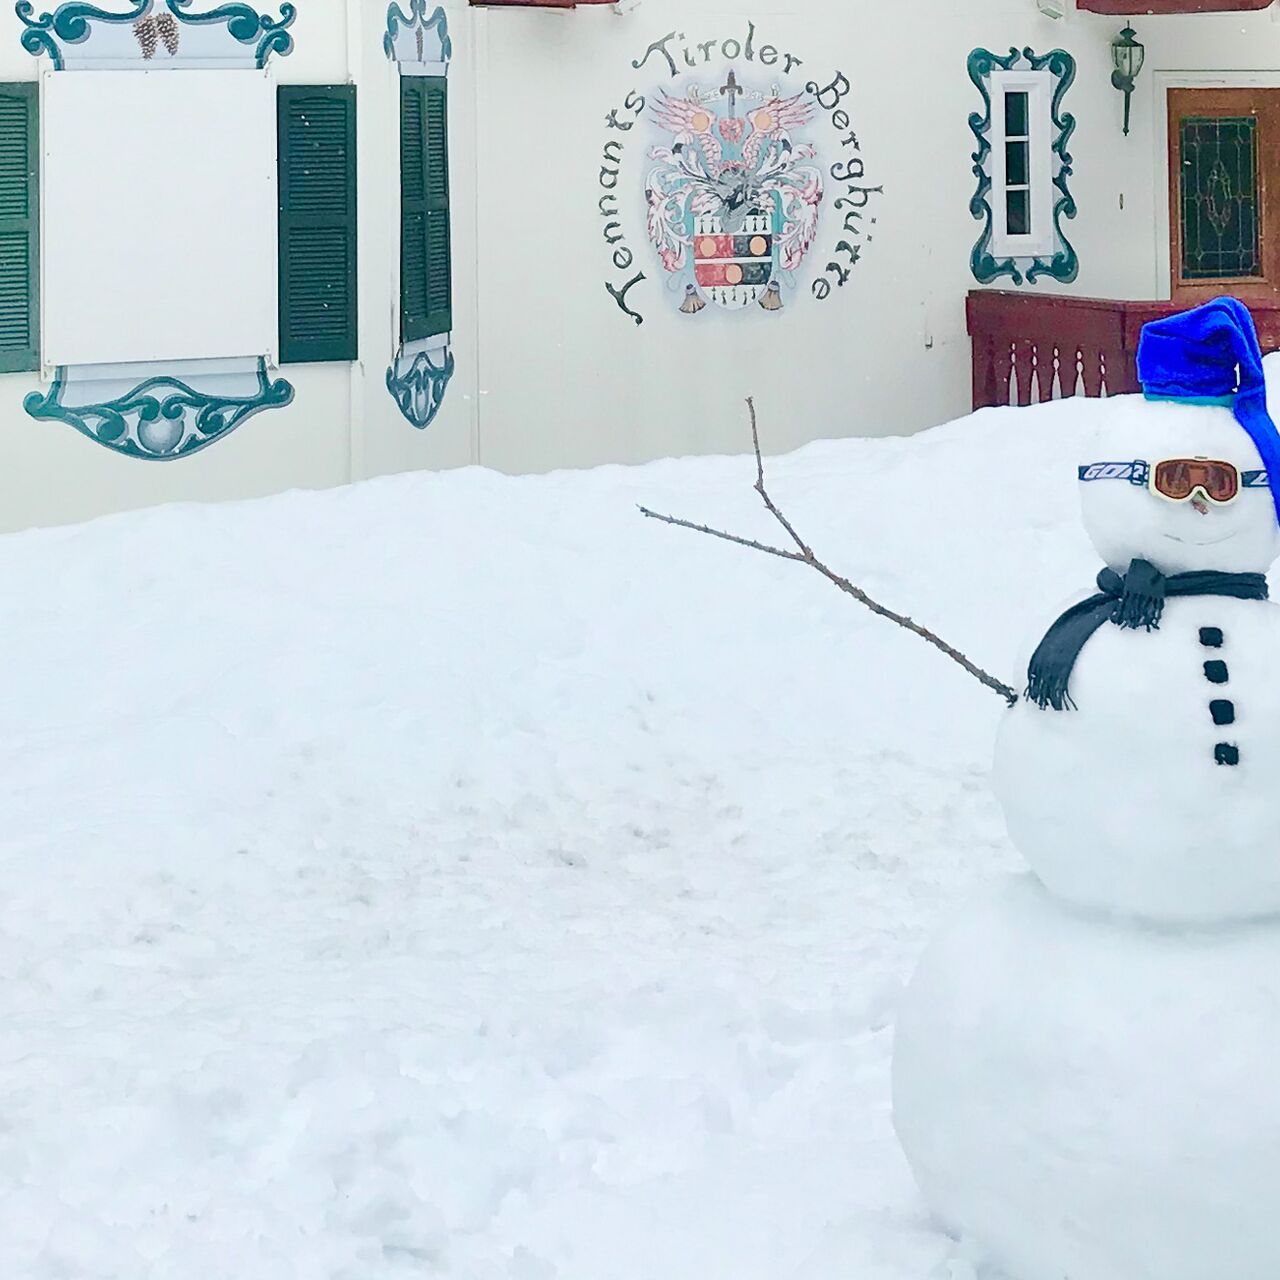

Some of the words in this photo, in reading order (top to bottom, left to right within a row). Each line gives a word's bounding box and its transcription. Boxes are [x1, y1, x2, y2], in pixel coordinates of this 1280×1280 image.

[598, 89, 647, 327] Tennants
[632, 20, 803, 78] Tiroler
[805, 70, 884, 301] Berghütte
